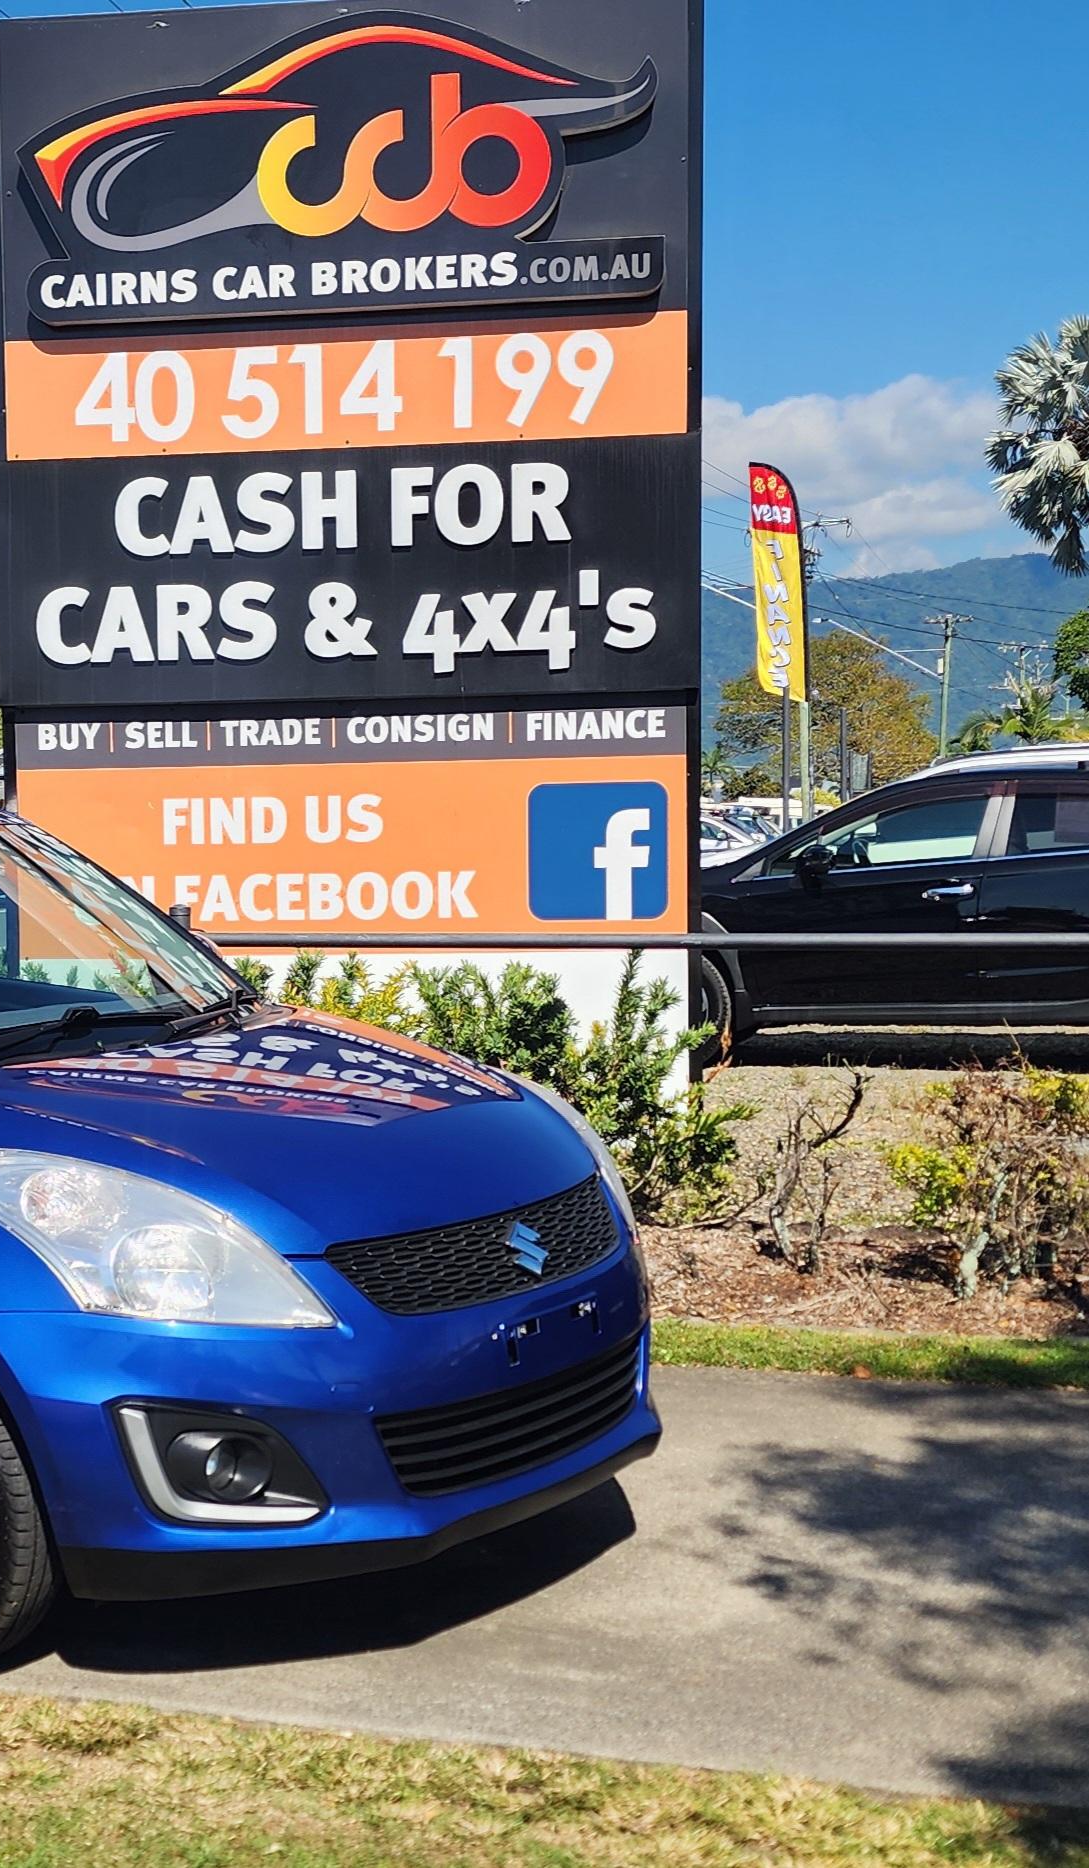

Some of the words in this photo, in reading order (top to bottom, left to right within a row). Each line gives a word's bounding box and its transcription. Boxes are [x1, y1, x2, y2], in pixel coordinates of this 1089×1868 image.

[40, 268, 198, 309] CAIRNS
[212, 264, 297, 301] CAR
[74, 350, 196, 443] 40
[220, 339, 403, 440] 514
[437, 328, 615, 429] 199
[114, 469, 358, 557] CASH
[390, 462, 573, 547] FOR
[36, 580, 278, 665] CARS
[304, 581, 378, 658] &
[36, 722, 103, 751] BUY
[124, 721, 199, 750] SELL
[219, 717, 322, 747] TRADE
[346, 712, 495, 745] CONSIGN
[526, 708, 667, 742] FINANCE
[162, 796, 288, 846] FIND
[304, 793, 384, 844] US
[170, 870, 479, 922] FACEBOOK
